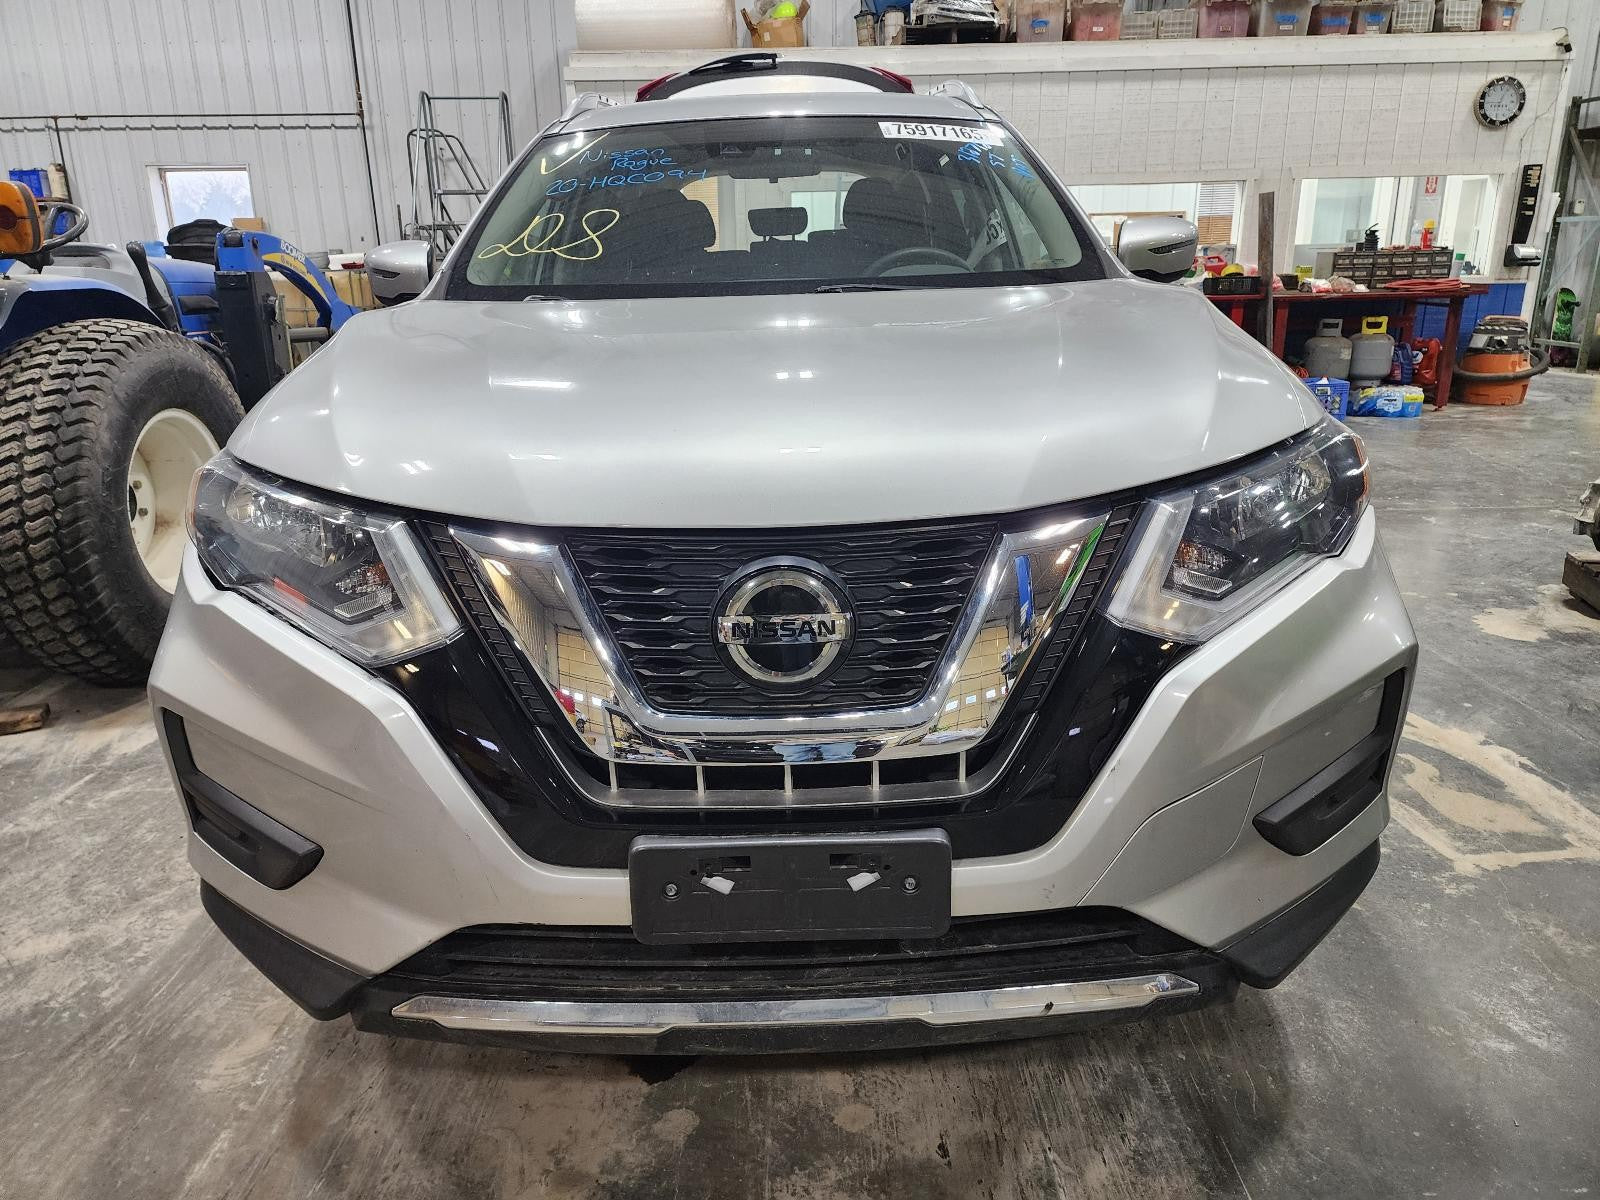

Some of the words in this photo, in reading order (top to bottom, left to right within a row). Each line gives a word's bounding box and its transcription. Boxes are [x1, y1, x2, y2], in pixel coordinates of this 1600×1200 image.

[892, 123, 983, 140] 75917165
[579, 148, 665, 164] Nissan
[610, 157, 677, 171] Rogue
[731, 619, 836, 639] NISSAN
